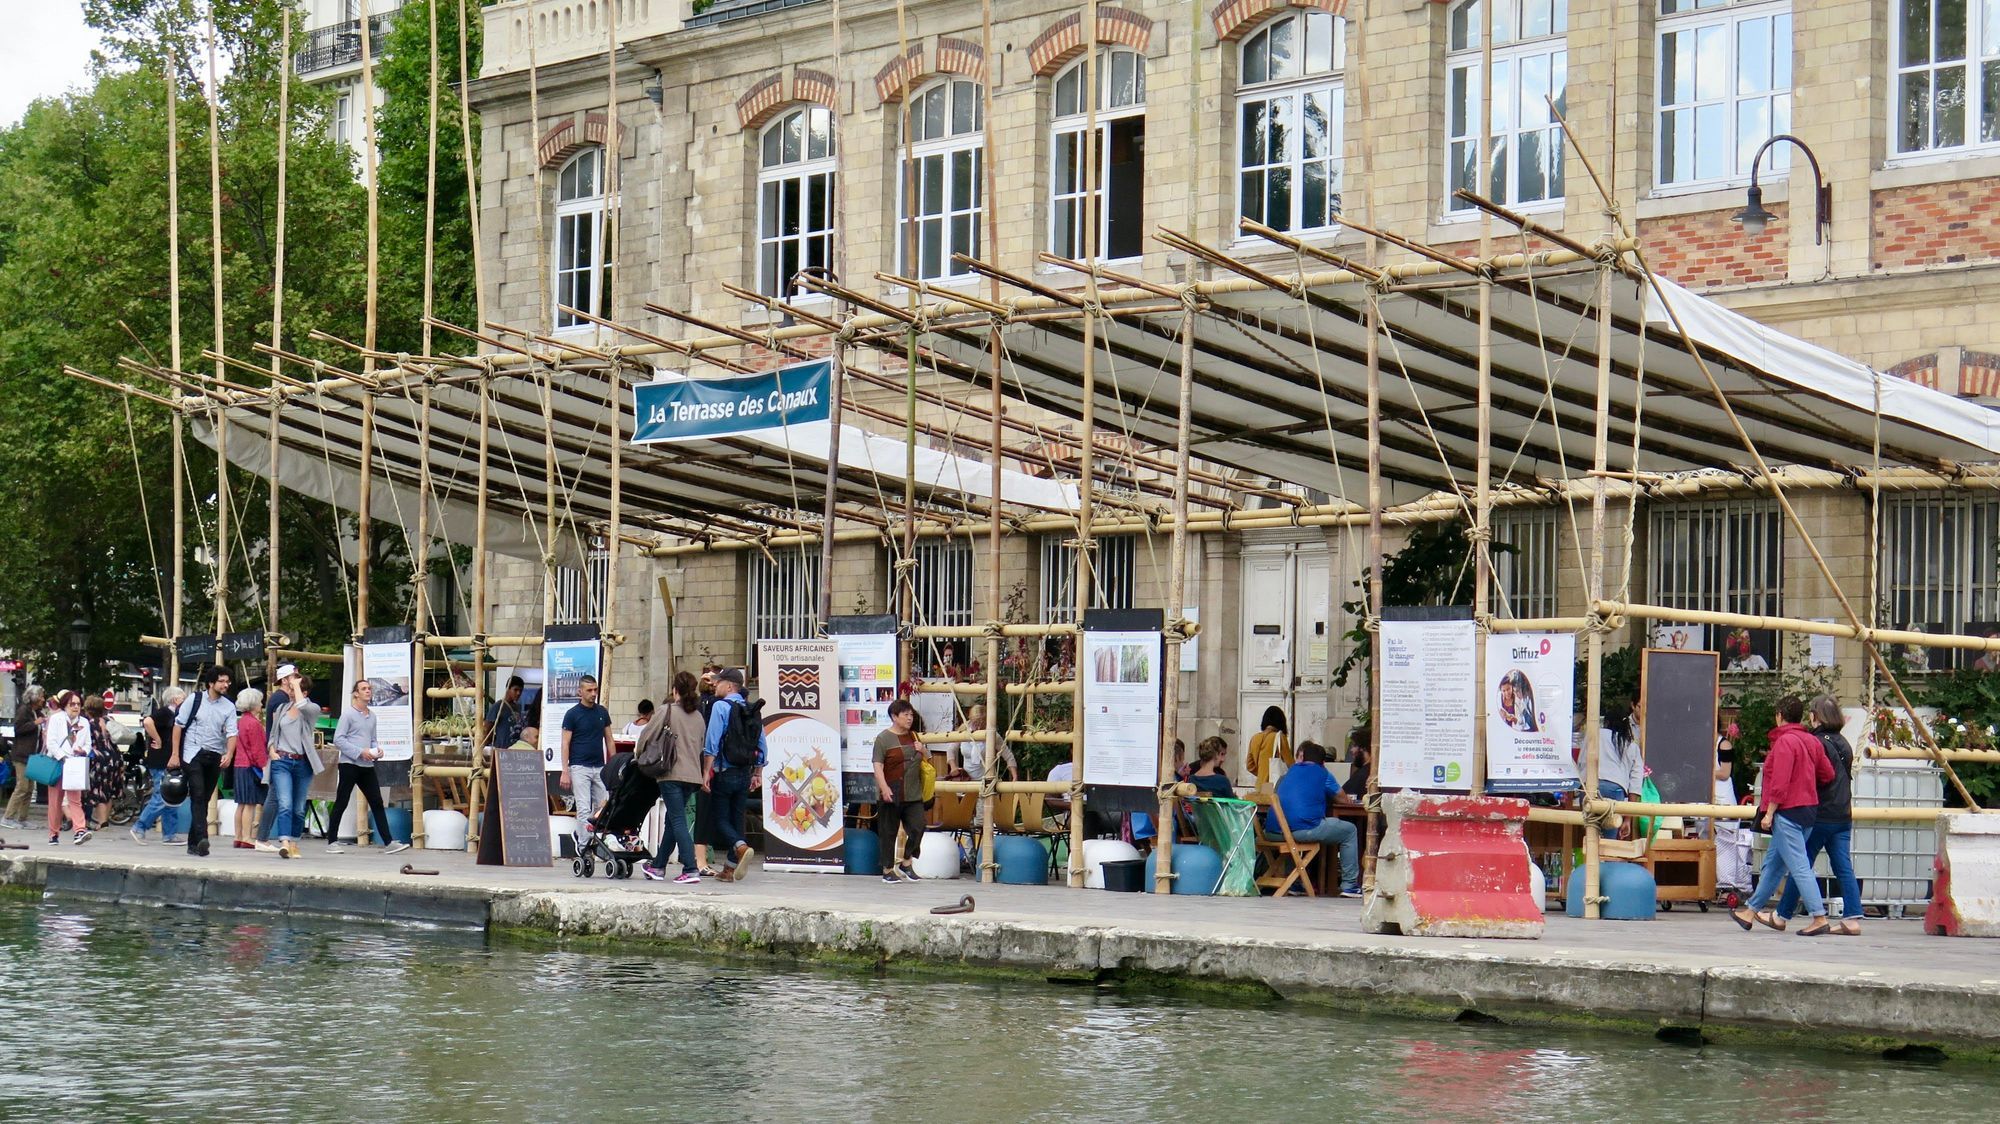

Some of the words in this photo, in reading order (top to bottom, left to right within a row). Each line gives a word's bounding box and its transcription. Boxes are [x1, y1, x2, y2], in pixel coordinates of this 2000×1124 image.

[649, 404, 665, 424] La
[670, 401, 735, 422] Terrasse
[738, 395, 764, 417] des
[768, 386, 818, 412] Canaux
[1512, 647, 1539, 659] Diffuz
[780, 691, 818, 708] YAR
[1514, 737, 1542, 745] Découvrez
[1536, 753, 1560, 761] solidaires
